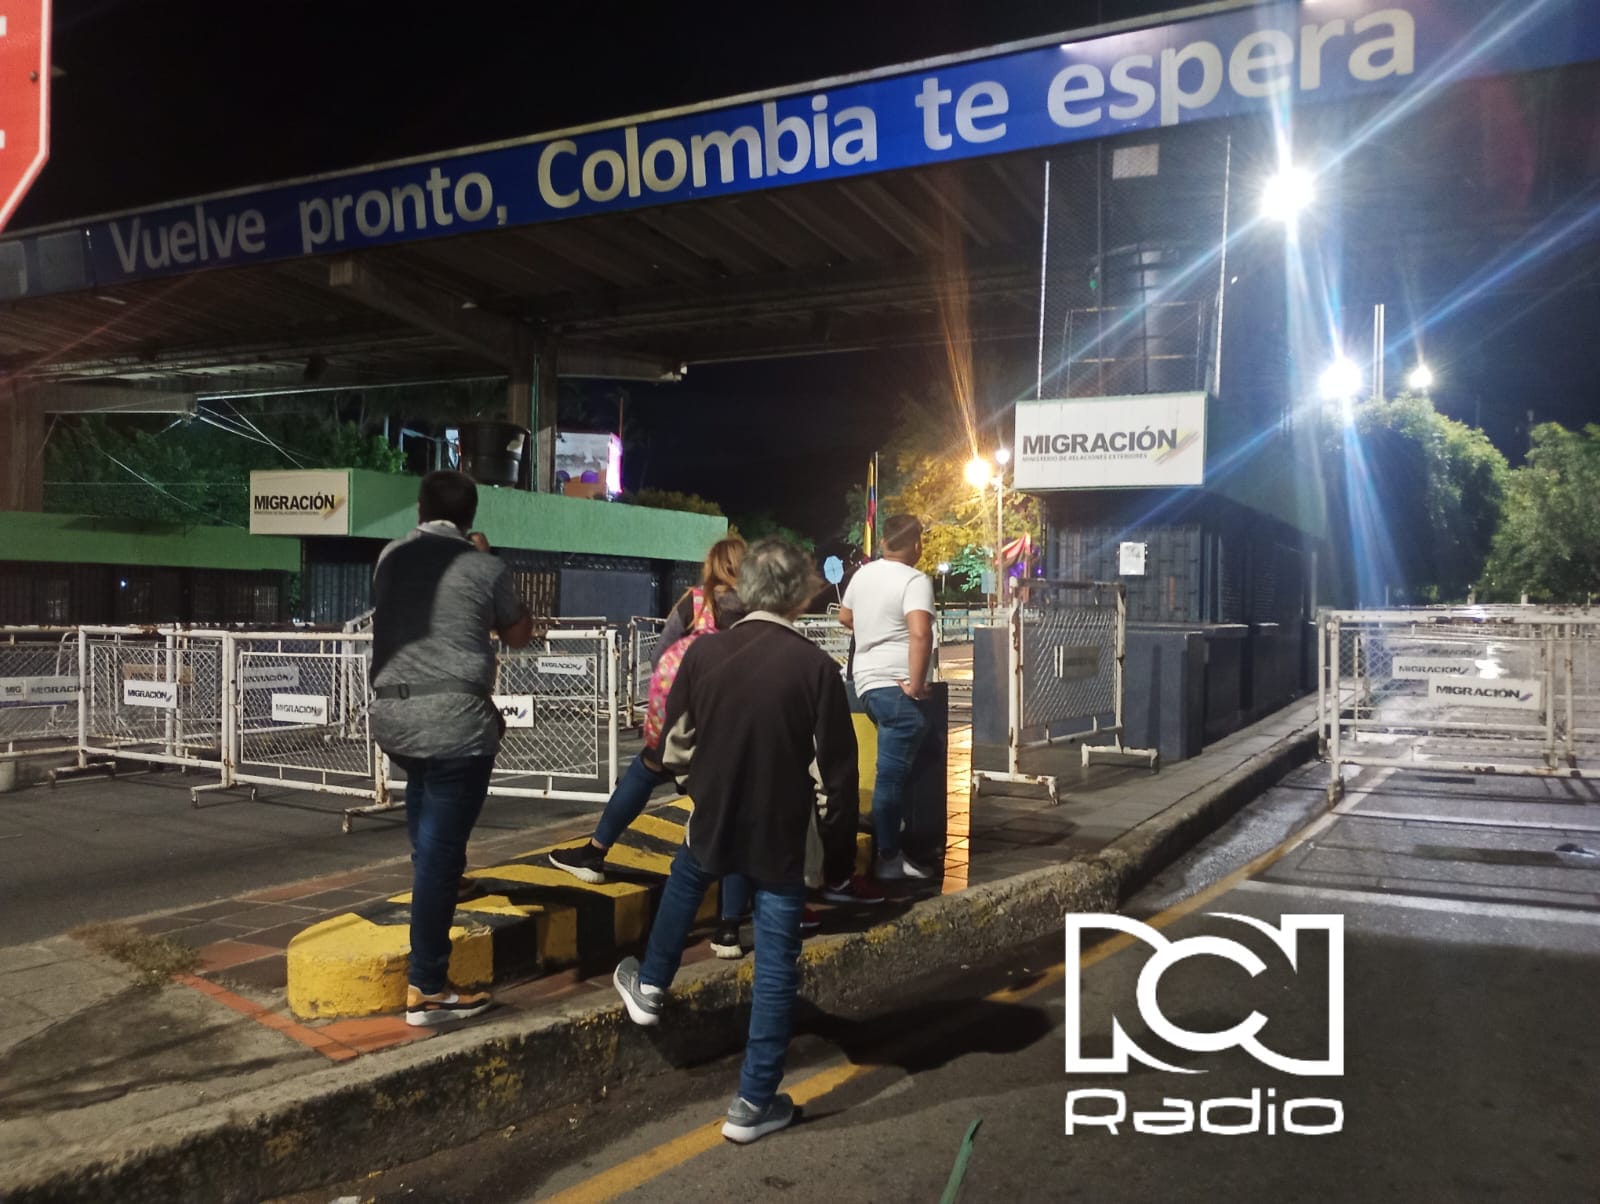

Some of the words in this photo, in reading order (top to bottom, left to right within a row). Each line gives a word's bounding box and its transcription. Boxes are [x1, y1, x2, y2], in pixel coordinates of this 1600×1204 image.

[109, 202, 266, 273] Vuelve
[299, 167, 508, 254] pronto,
[537, 95, 878, 209] Colombia
[914, 76, 1009, 151] te
[1047, 8, 1415, 128] espera
[1022, 426, 1177, 455] MIGRACIÓN
[254, 491, 335, 510] MIGRACIÓN
